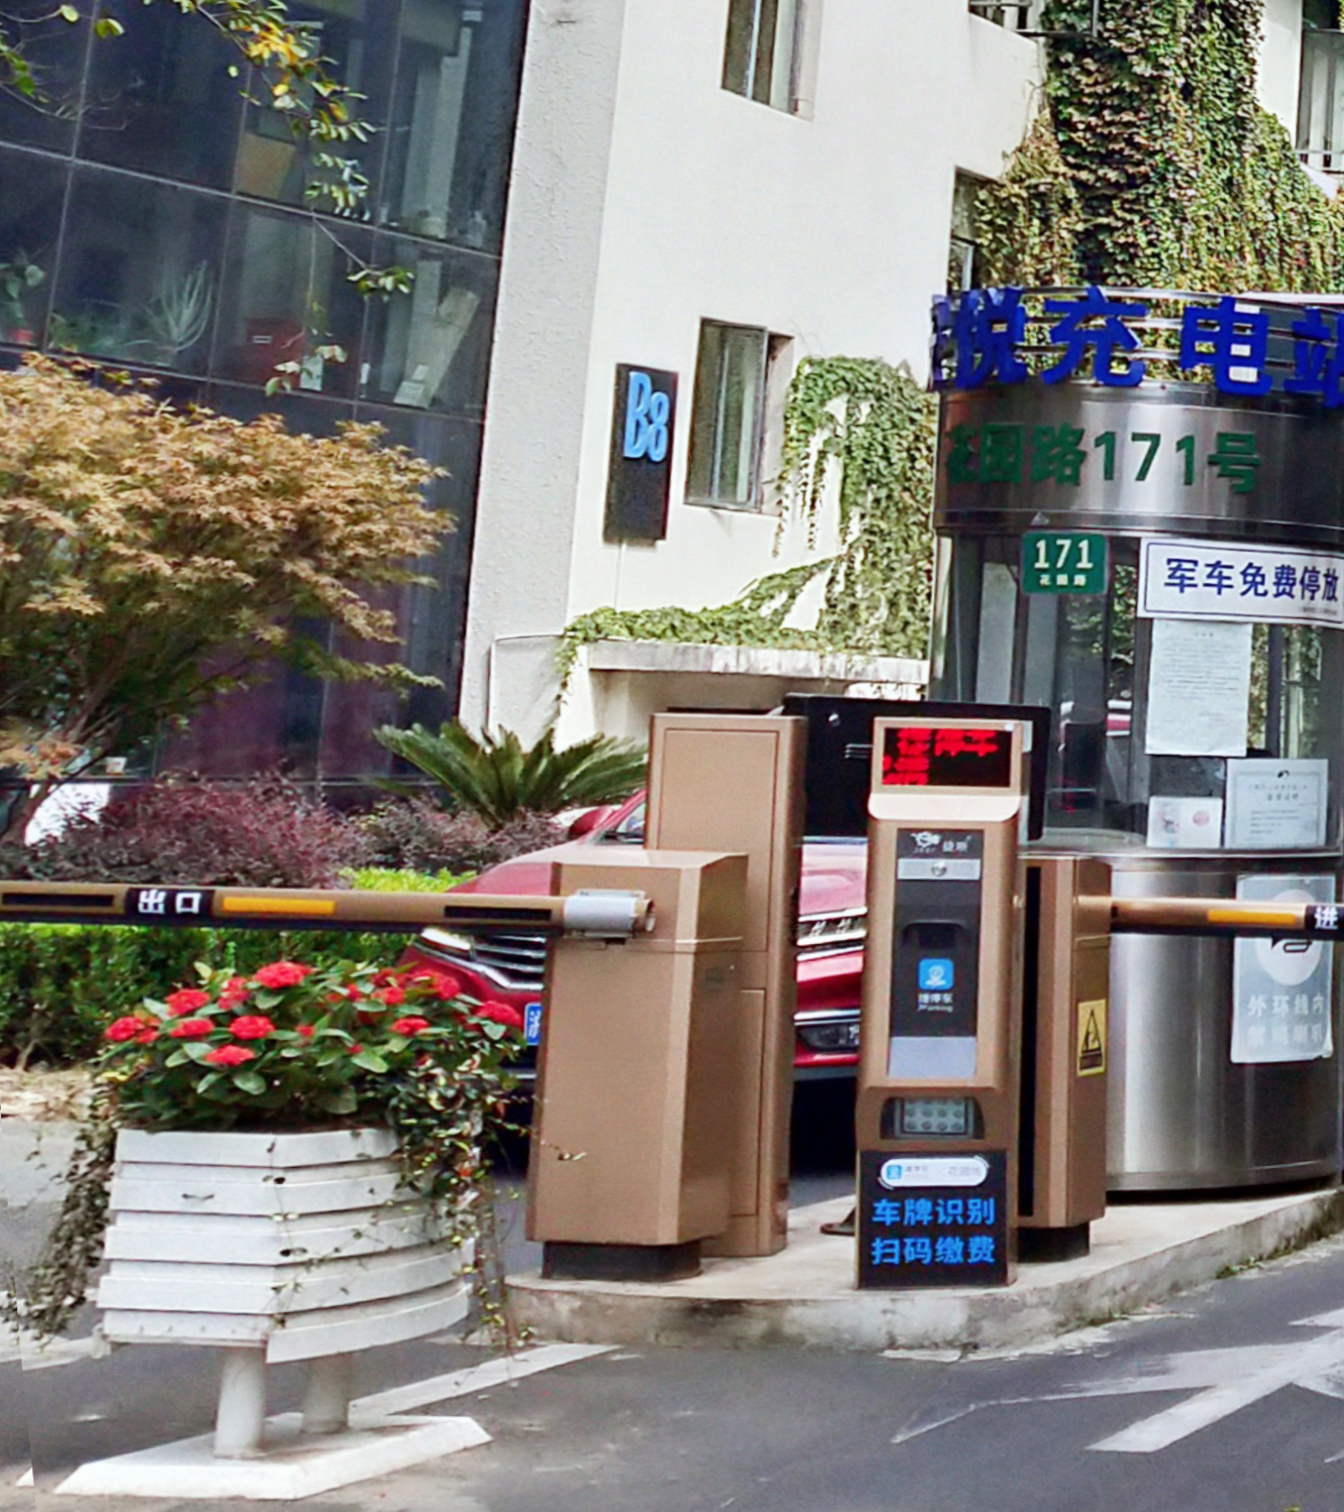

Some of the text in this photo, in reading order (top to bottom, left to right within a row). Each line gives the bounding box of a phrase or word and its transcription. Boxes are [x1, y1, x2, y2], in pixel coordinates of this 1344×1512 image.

[624, 371, 669, 462] B8
[1034, 539, 1094, 570] 171
[1164, 557, 1340, 603] 军车免费停放
[138, 889, 202, 914] 出口
[872, 1197, 995, 1226] 车牌识别
[871, 1235, 995, 1265] 扫码缴费
